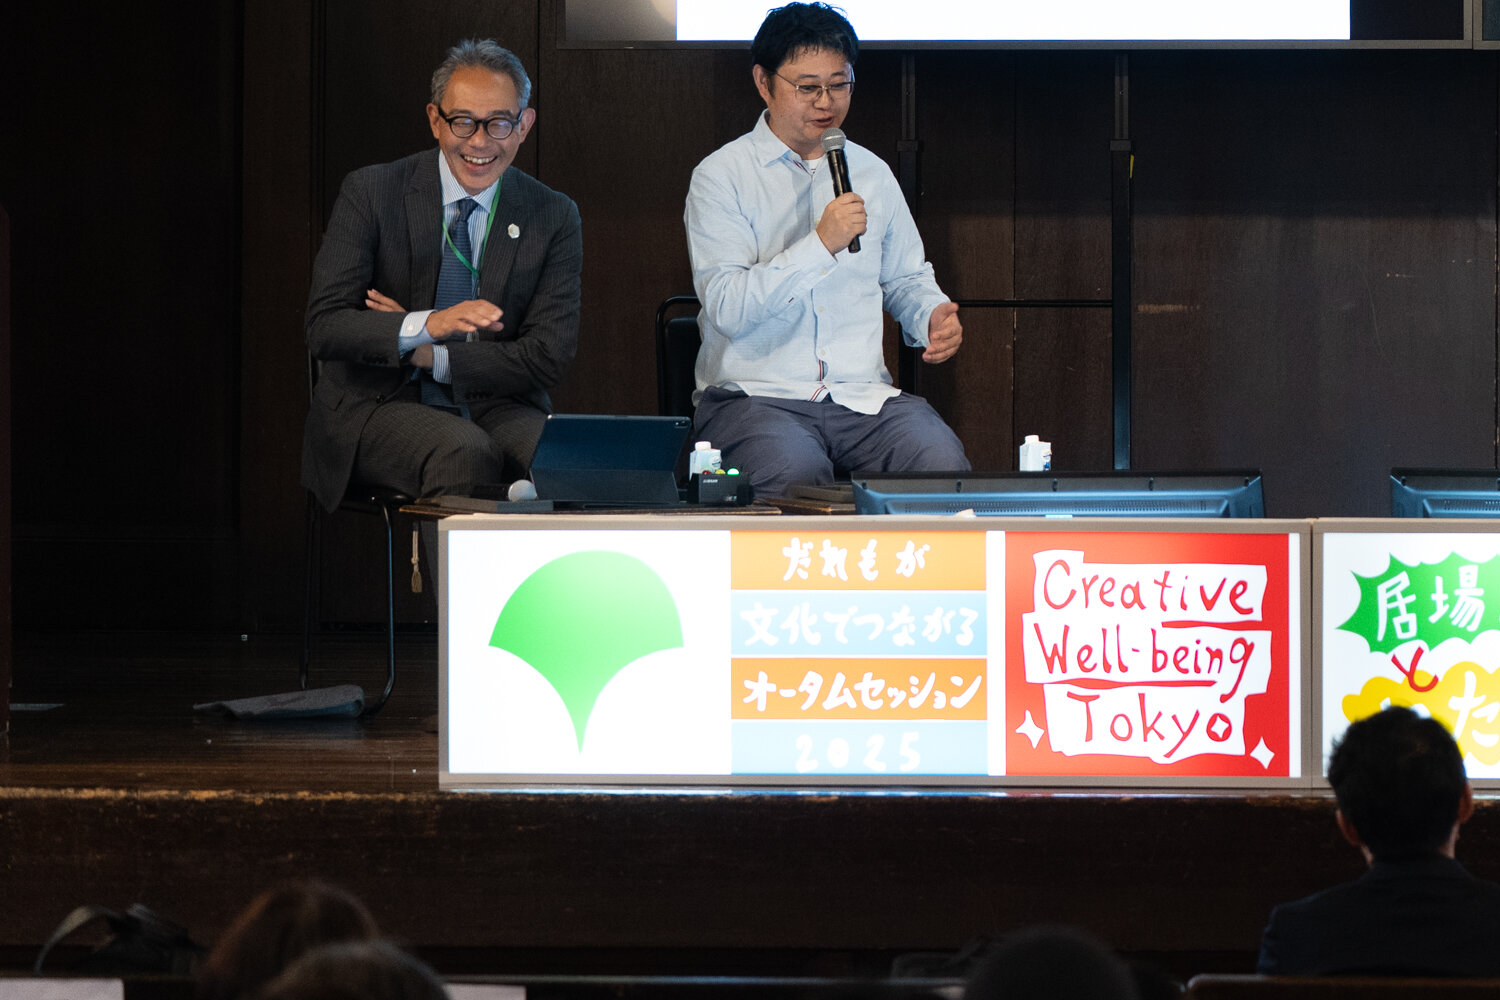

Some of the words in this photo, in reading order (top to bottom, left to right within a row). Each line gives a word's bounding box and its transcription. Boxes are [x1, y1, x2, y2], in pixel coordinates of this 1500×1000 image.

[781, 536, 931, 582] だれもが
[1043, 559, 1254, 615] Creative
[739, 601, 979, 647] 文化でつながる
[1033, 622, 1255, 704] Well-being
[1390, 645, 1440, 694] と
[742, 670, 982, 713] オータムセッション
[1066, 690, 1233, 758] Tokyo
[794, 730, 921, 773] 2025
